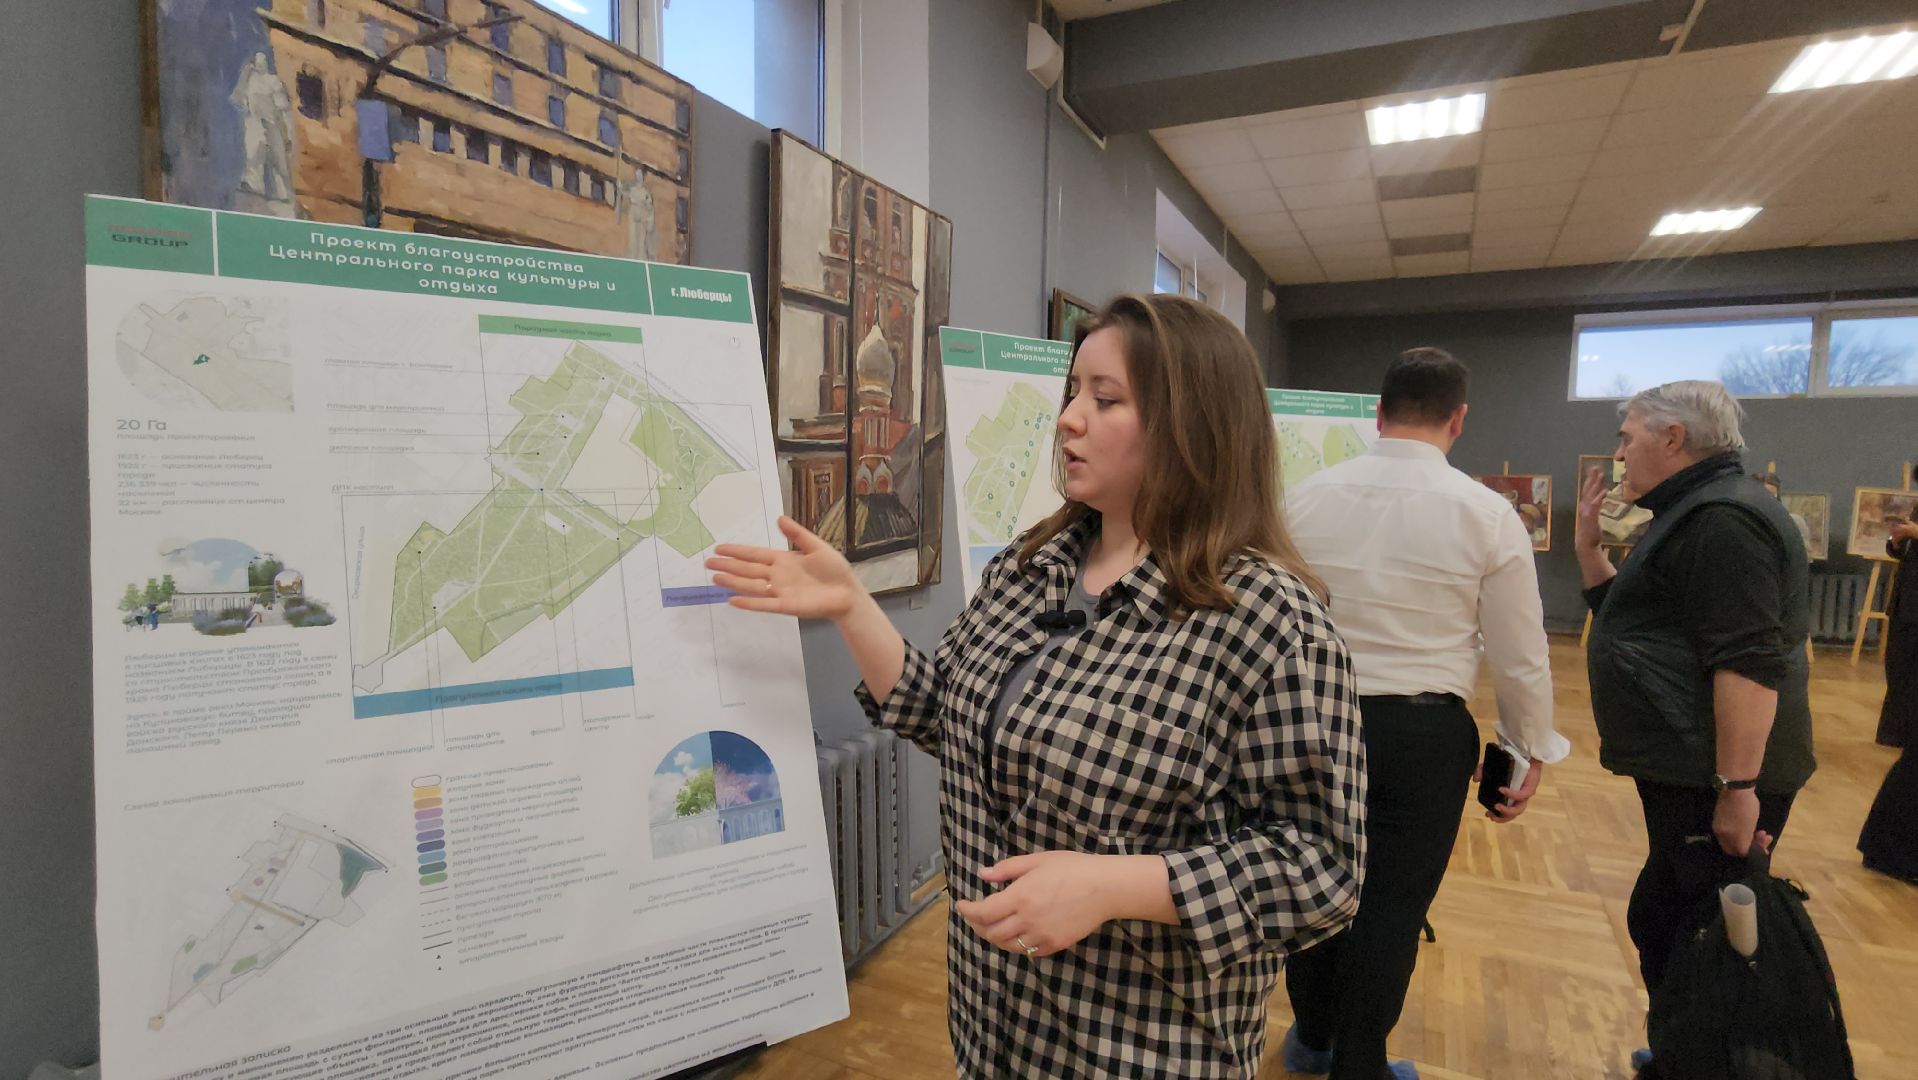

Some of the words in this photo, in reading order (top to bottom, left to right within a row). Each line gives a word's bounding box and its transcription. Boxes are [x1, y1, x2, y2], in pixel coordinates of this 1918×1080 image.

[112, 233, 189, 248] GROUP
[310, 231, 397, 252] Проект
[405, 241, 584, 273] благоустройства
[269, 244, 435, 273] Центрального
[442, 264, 500, 281] парка
[507, 271, 601, 290] культуры
[606, 281, 616, 291] и
[418, 277, 498, 295] отдыха
[1014, 342, 1045, 354] Проект
[1000, 350, 1059, 364] Центрального
[116, 419, 141, 431] 20
[148, 419, 168, 431] Га
[241, 1044, 292, 1066] записка
